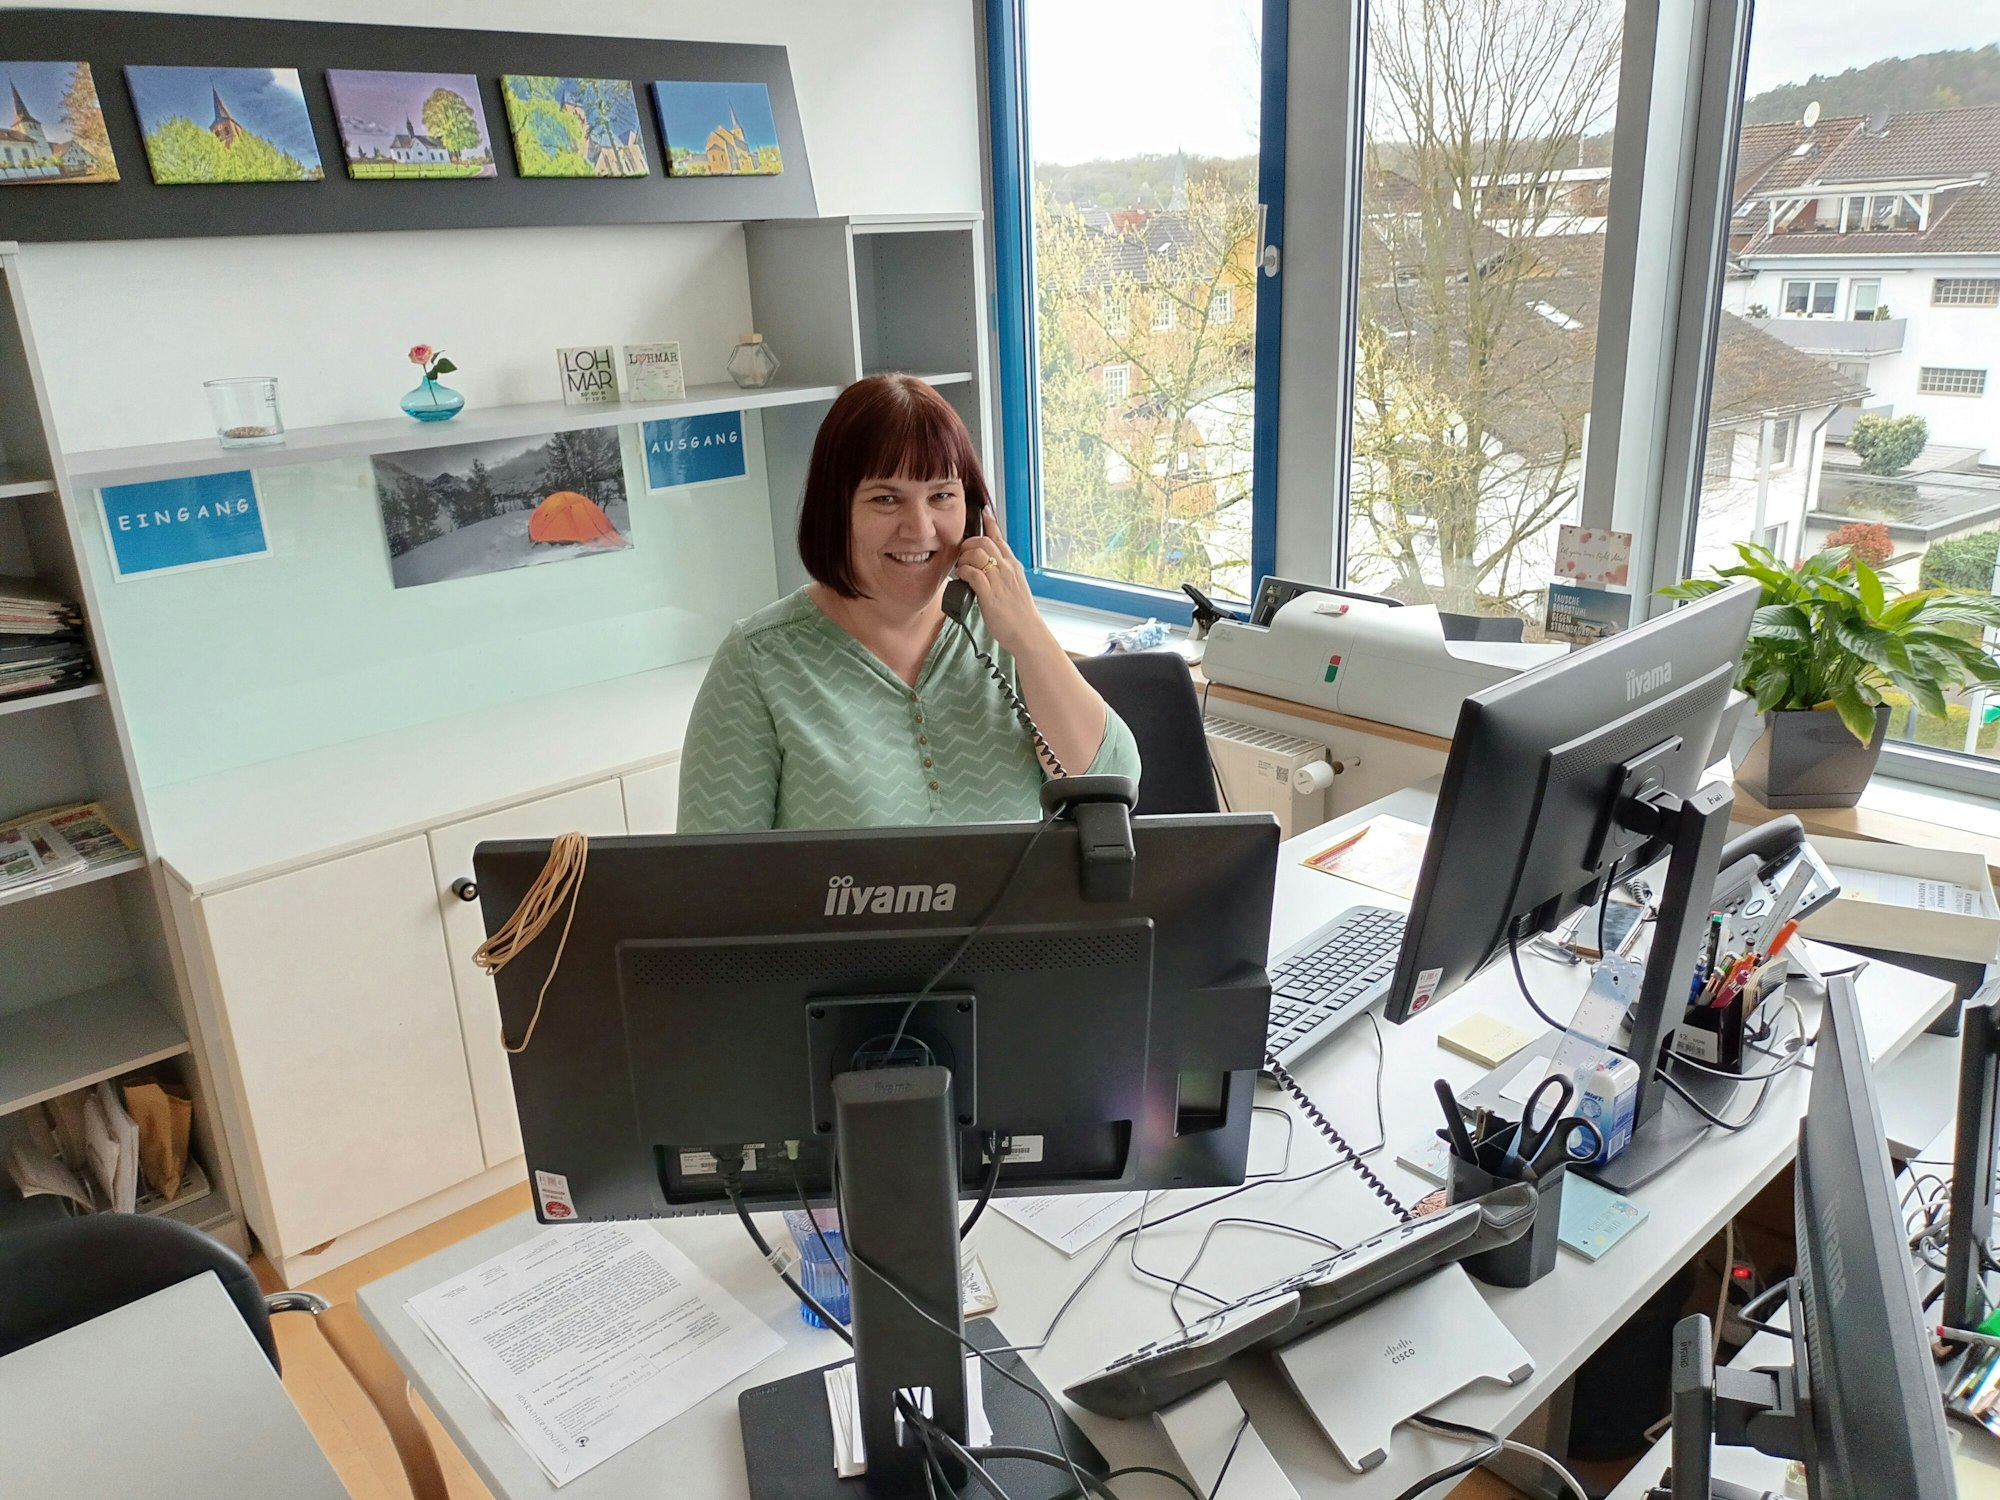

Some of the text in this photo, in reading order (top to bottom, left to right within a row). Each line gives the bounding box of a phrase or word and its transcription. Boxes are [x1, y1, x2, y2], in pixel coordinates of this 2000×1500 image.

[564, 349, 611, 372] LOH
[628, 352, 679, 364] LHMAR
[567, 370, 613, 392] MAR
[651, 431, 738, 454] AUSGANG
[118, 498, 250, 531] EINGANG
[1625, 661, 1672, 702] iiyama
[823, 875, 957, 916] iiyama
[1391, 1348, 1416, 1364] CISCO
